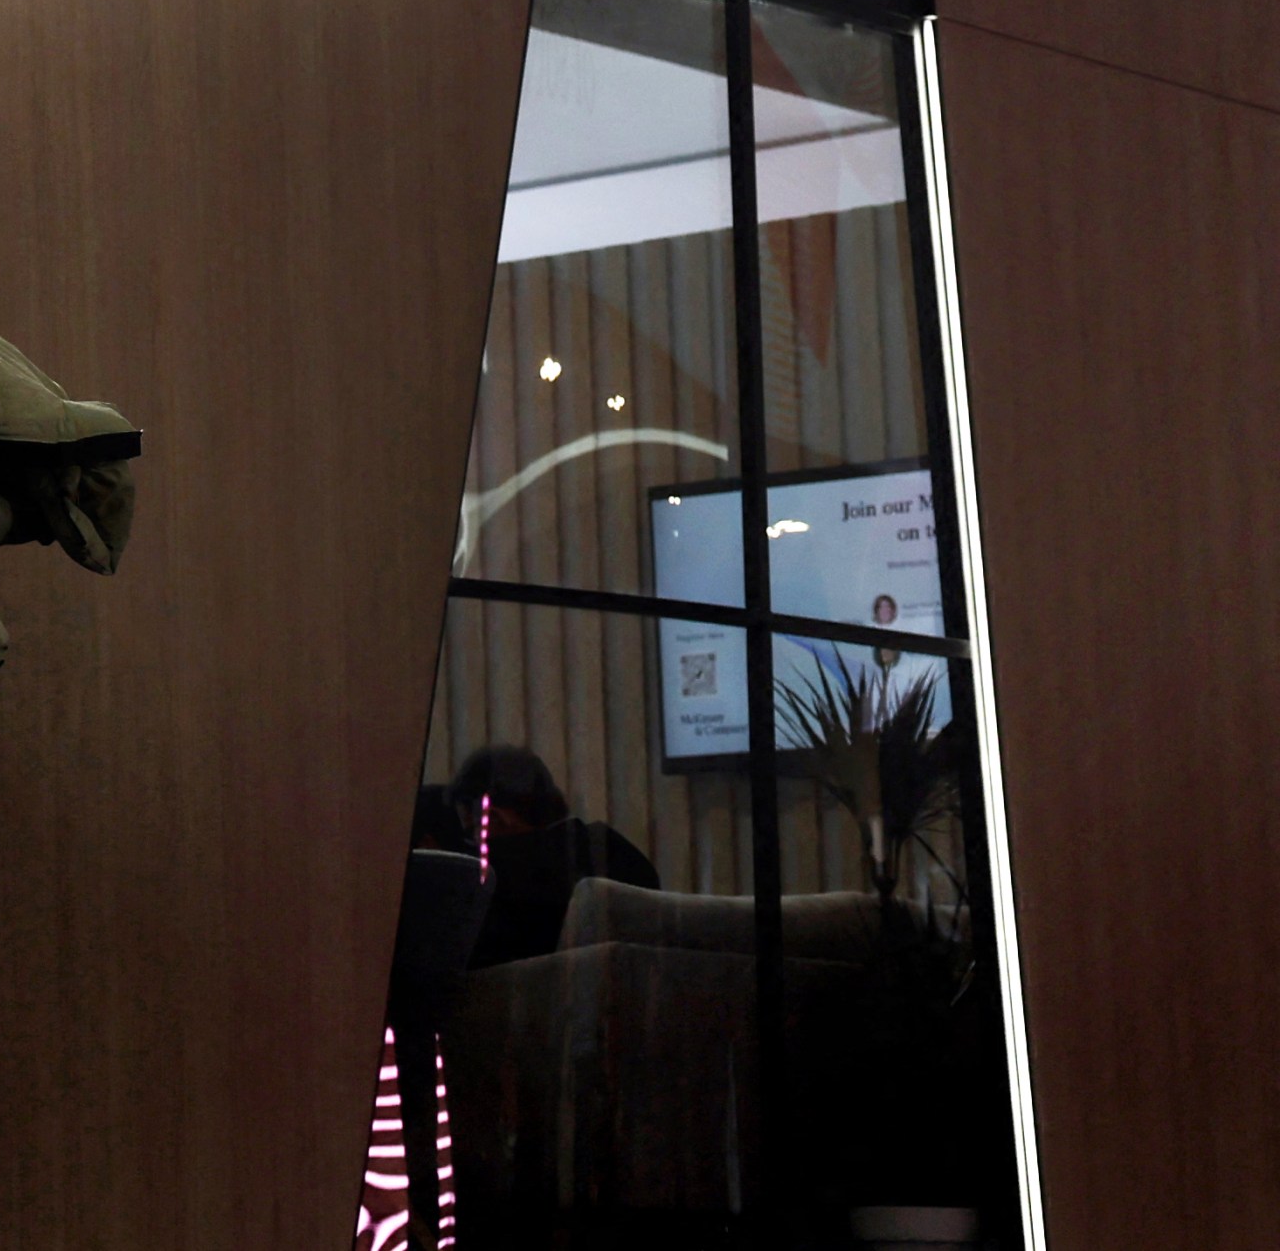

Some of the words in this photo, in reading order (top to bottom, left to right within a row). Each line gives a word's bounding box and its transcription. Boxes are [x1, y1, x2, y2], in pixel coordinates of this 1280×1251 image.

[841, 500, 878, 522] Join
[882, 499, 914, 516] our
[896, 526, 920, 542] on
